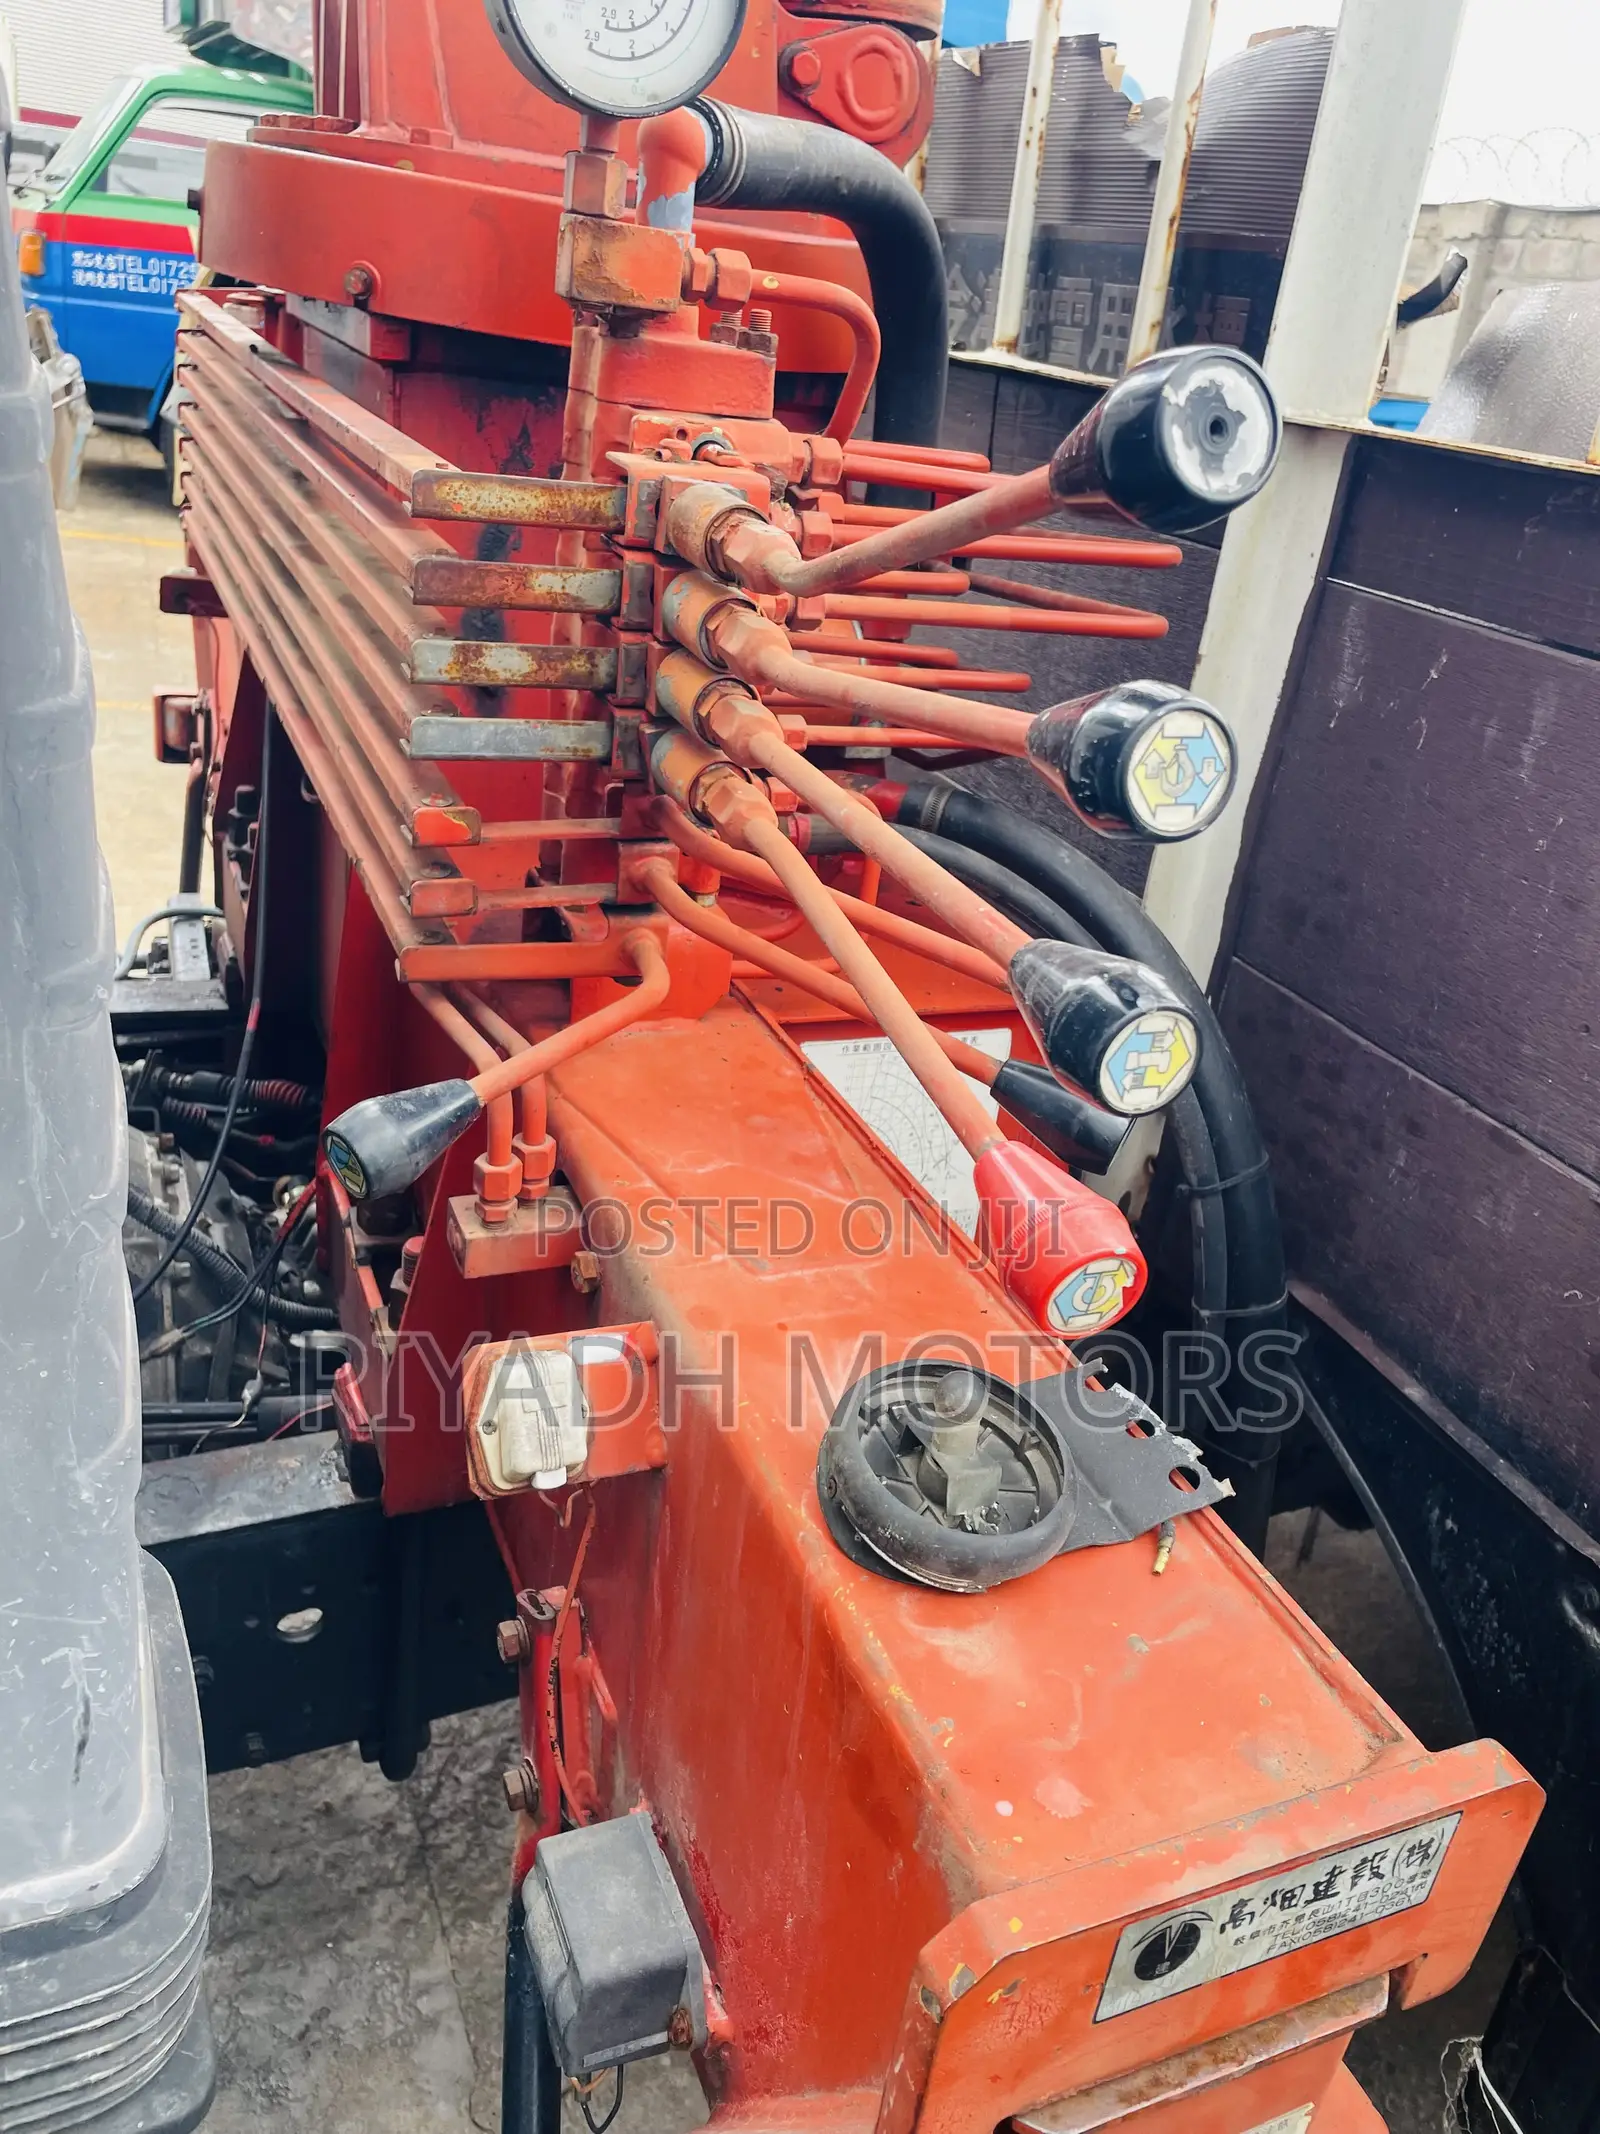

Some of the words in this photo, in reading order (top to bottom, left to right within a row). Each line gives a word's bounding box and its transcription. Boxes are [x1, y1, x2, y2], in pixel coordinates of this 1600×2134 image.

[601, 7, 617, 20] 2.9
[628, 9, 635, 20] 2
[584, 30, 600, 42] 2.9
[628, 39, 635, 50] 2
